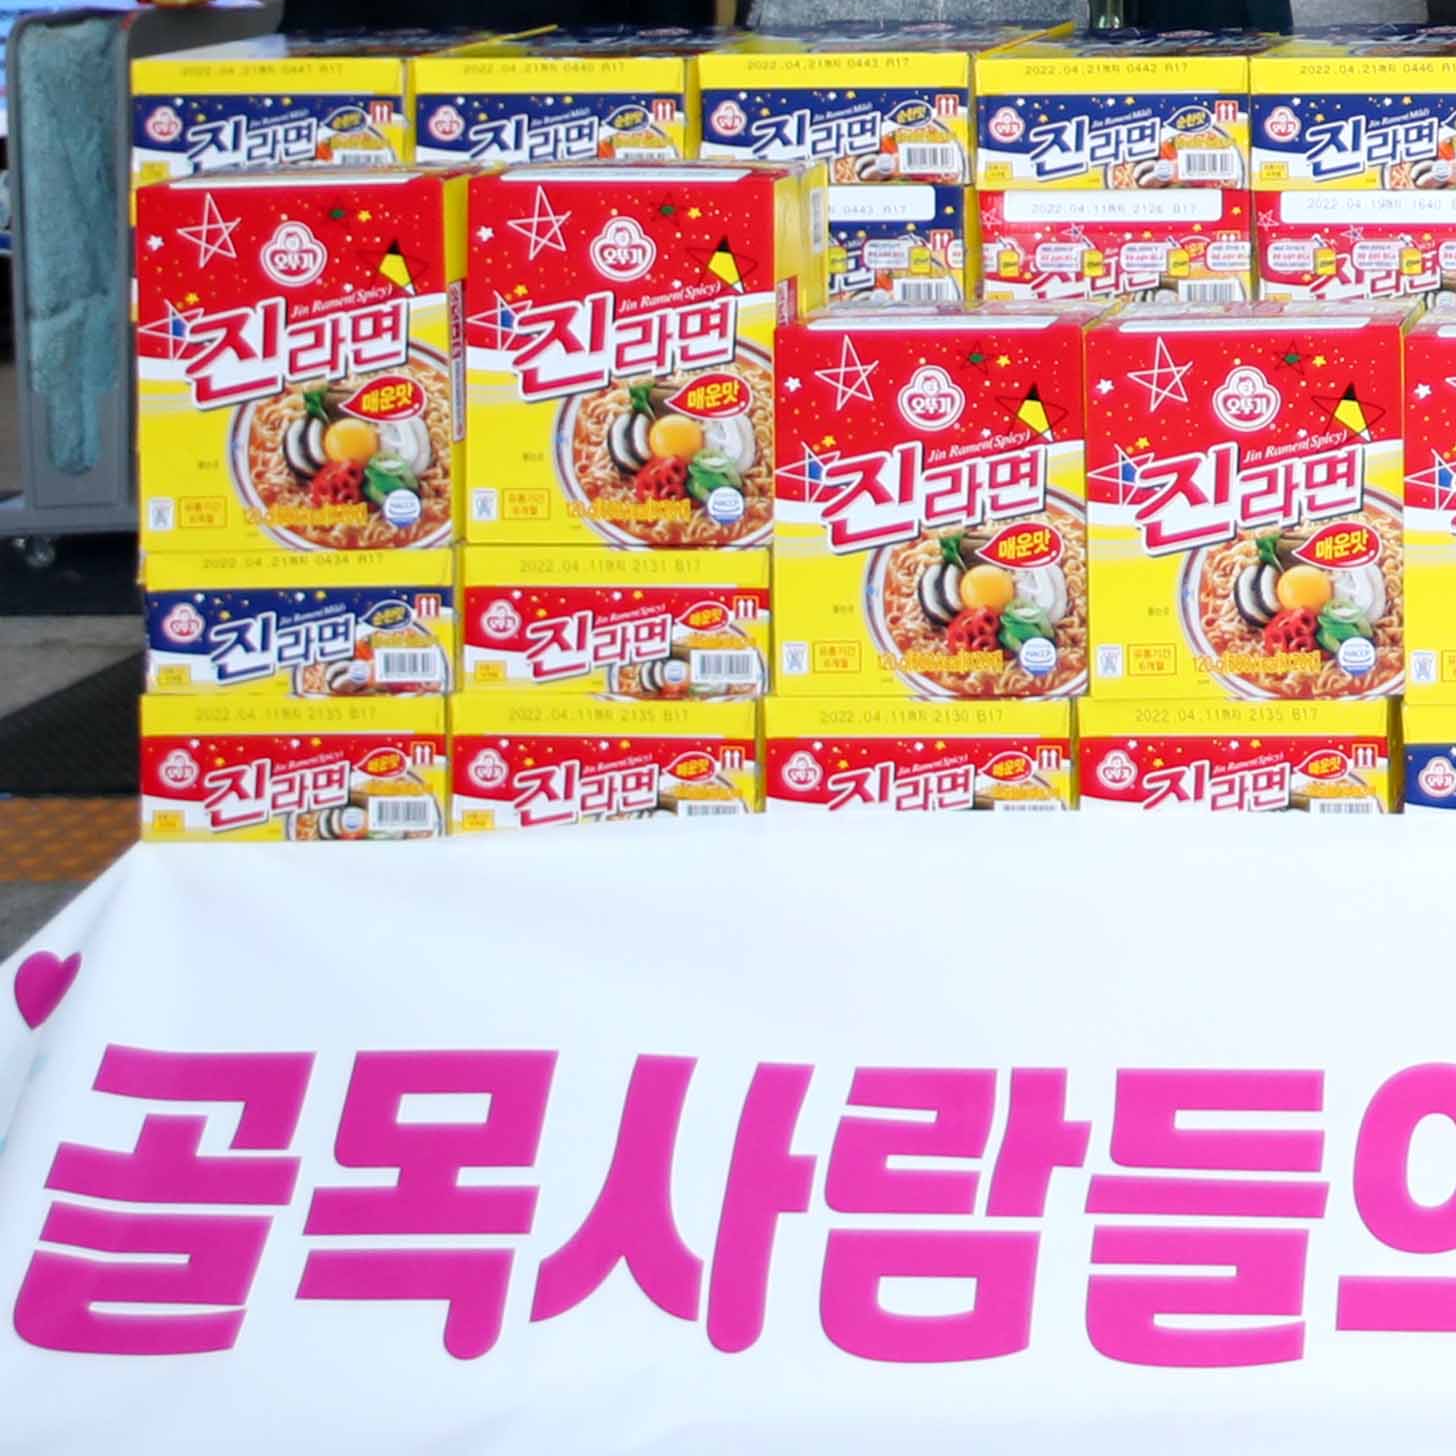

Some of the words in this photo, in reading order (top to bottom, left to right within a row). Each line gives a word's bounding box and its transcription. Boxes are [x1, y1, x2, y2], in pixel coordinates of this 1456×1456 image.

[1029, 116, 1160, 180] 진라면
[1305, 115, 1439, 180] 진라면
[272, 254, 314, 270] 오뚜기
[601, 249, 643, 265] 오뚜기
[291, 304, 309, 318] Jin
[619, 299, 637, 313] Jin
[185, 298, 407, 406] 진라면
[511, 292, 735, 401] 진라면
[361, 383, 414, 412] 매운맛
[687, 380, 741, 409] 매운맛
[909, 398, 952, 415] 오뚜기
[1224, 398, 1268, 415] 오뚜기
[928, 449, 946, 463] Jin
[1243, 449, 1262, 464] Jin
[821, 442, 1045, 551] 진라면
[1136, 442, 1363, 552] 진라면
[998, 530, 1052, 559] 매운맛
[1315, 529, 1370, 559] 매운맛
[210, 612, 355, 683] 진라면
[525, 611, 671, 684] 진라면
[203, 759, 349, 832] 진라면
